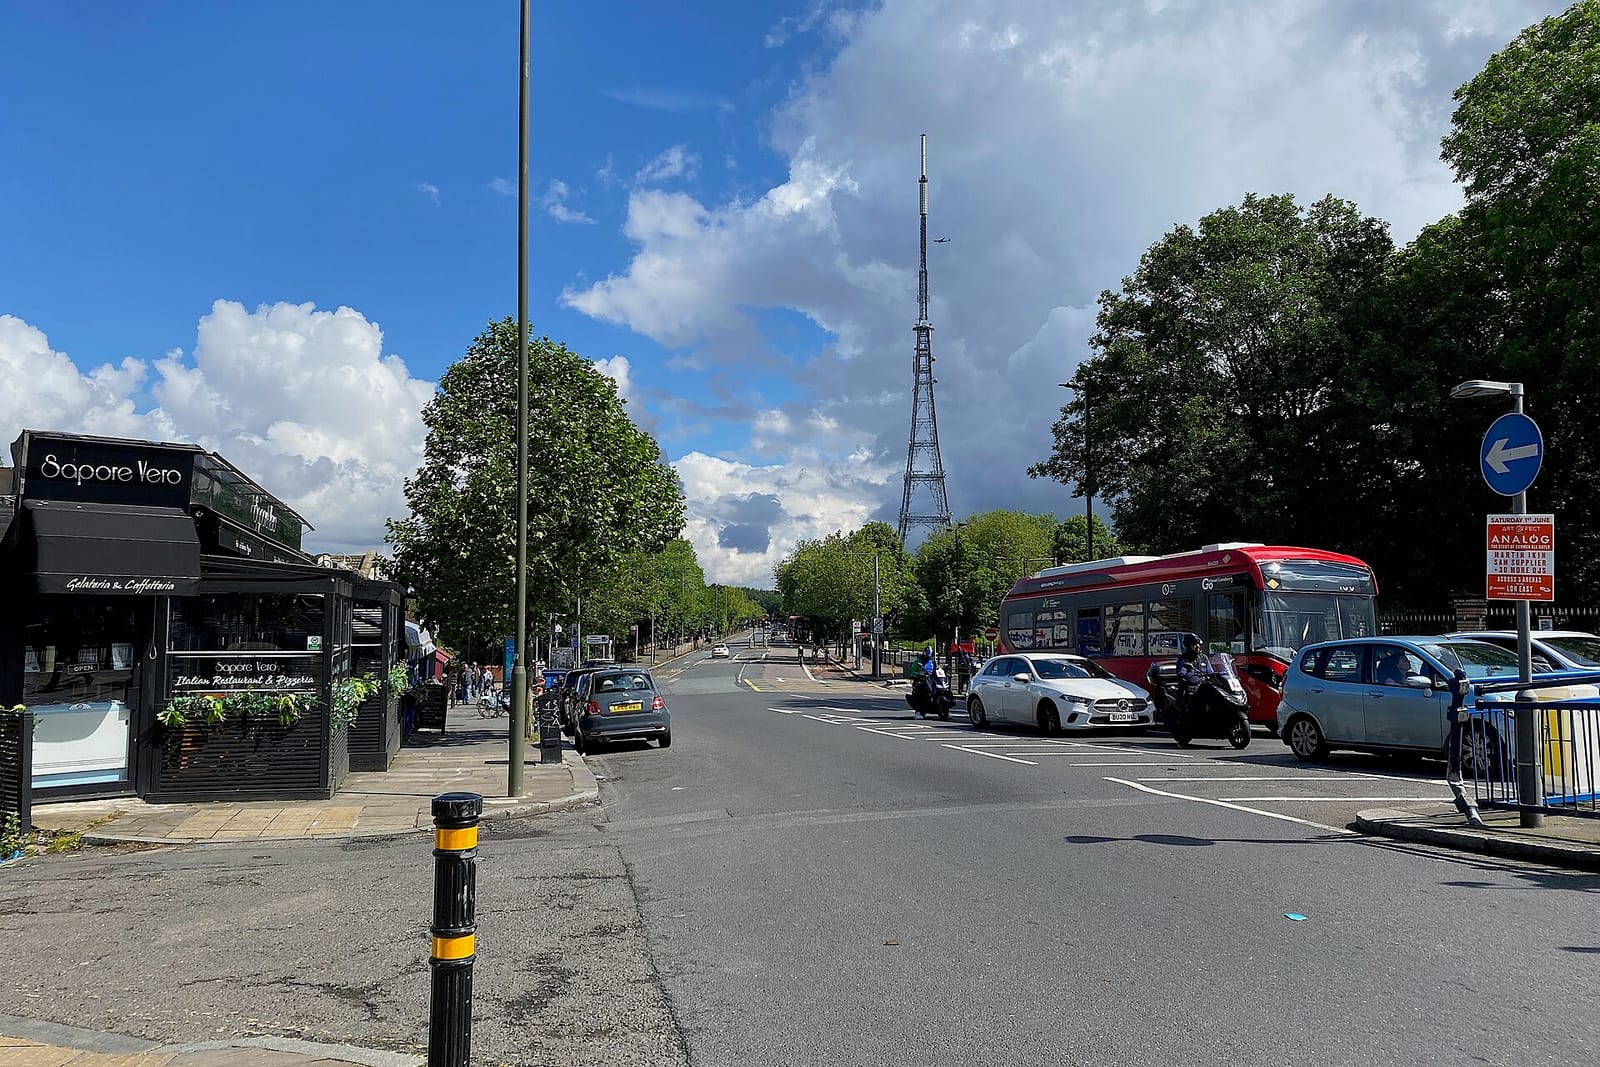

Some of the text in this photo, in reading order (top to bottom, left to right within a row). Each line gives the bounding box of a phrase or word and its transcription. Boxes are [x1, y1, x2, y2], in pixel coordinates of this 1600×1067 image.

[41, 454, 182, 486] Sapore Vero
[1491, 534, 1550, 544] ANALOG
[66, 576, 111, 591] Gelateria
[124, 578, 175, 594] Caffetteria
[1202, 578, 1214, 590] Go
[215, 661, 277, 674] Sapore Vero
[175, 674, 315, 688] Italian Restaurant & Pizzeria
